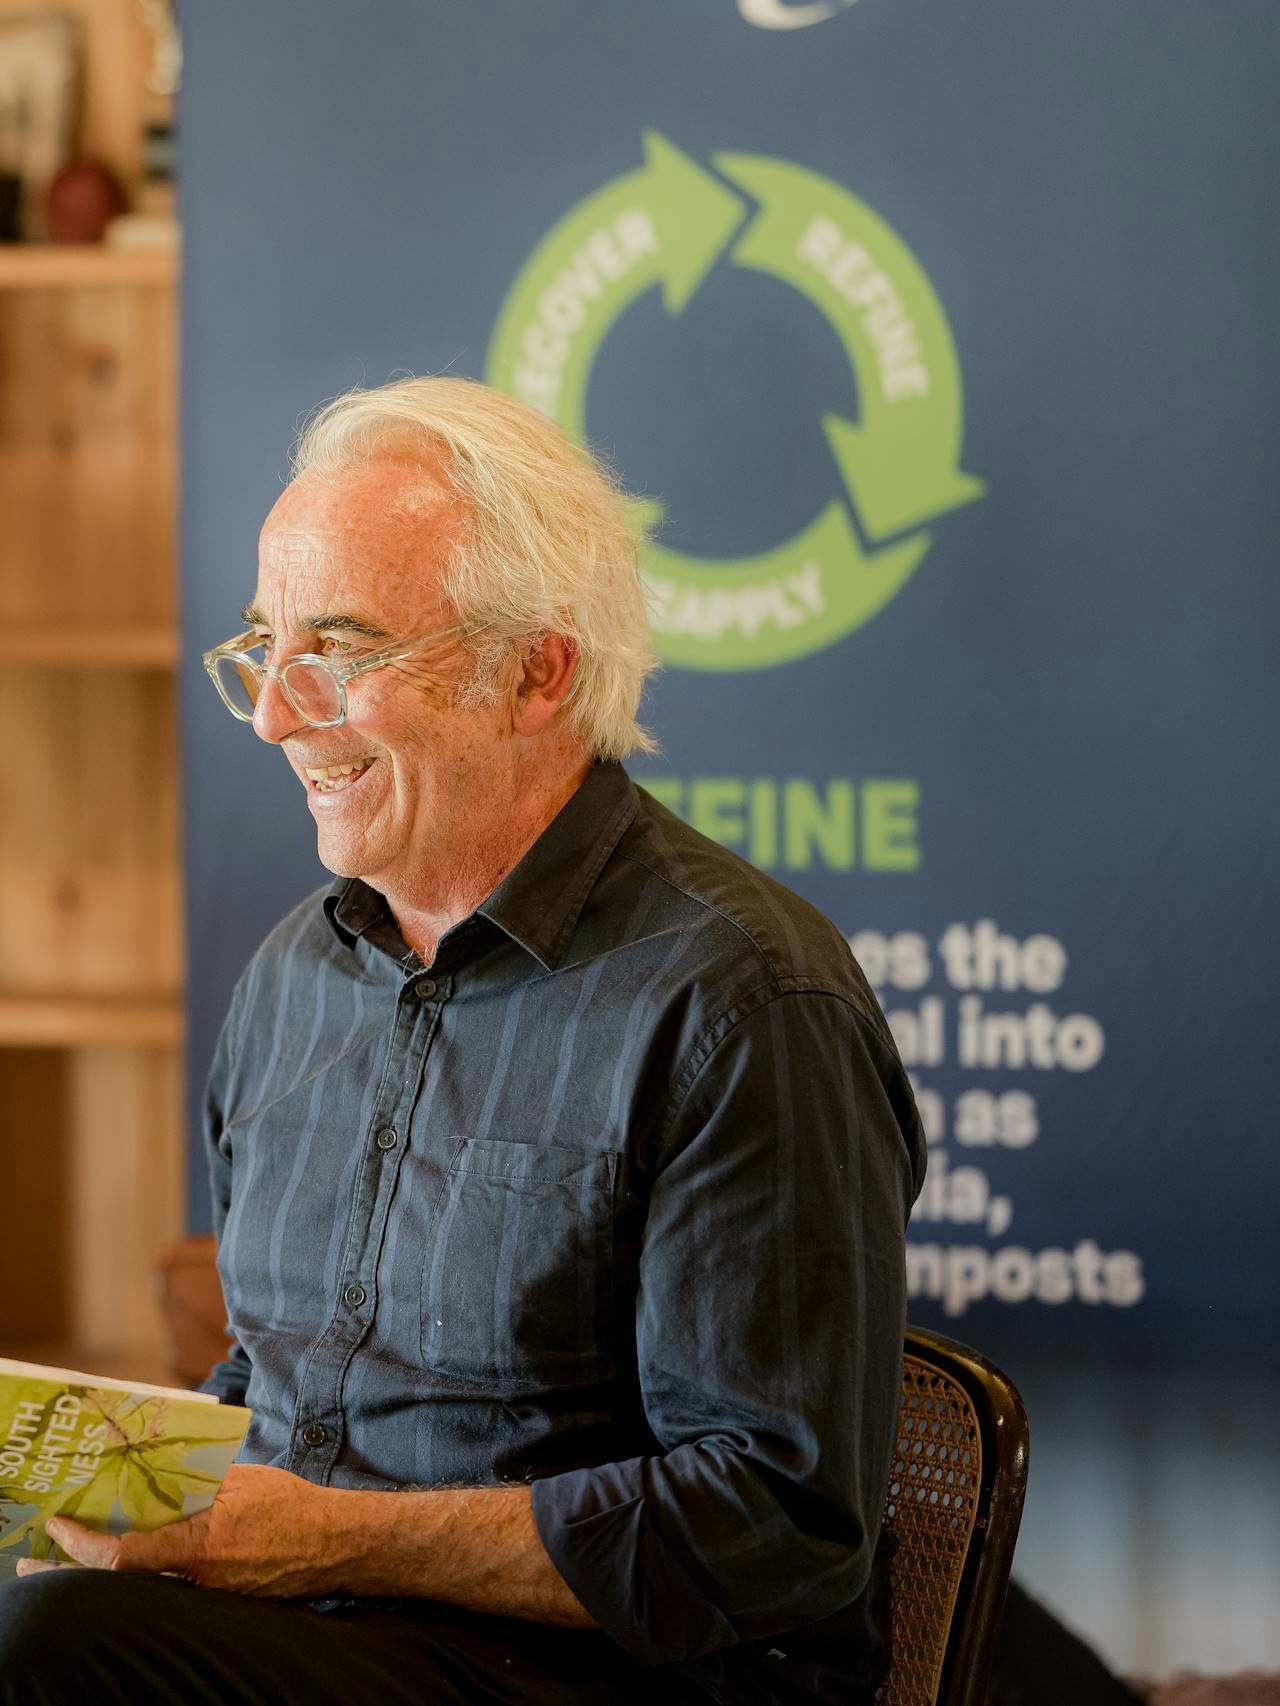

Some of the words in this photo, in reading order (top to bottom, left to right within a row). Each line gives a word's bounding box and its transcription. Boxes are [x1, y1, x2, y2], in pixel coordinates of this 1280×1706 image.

[513, 209, 660, 421] ECOVER
[796, 215, 929, 401] REFINE
[641, 562, 826, 639] EAPPLY
[634, 777, 921, 871] FINE
[940, 918, 1067, 993] the
[958, 992, 1106, 1073] into
[954, 1089, 1039, 1148] as
[23, 1394, 81, 1493] SIGHTED
[65, 1422, 109, 1485] NESS
